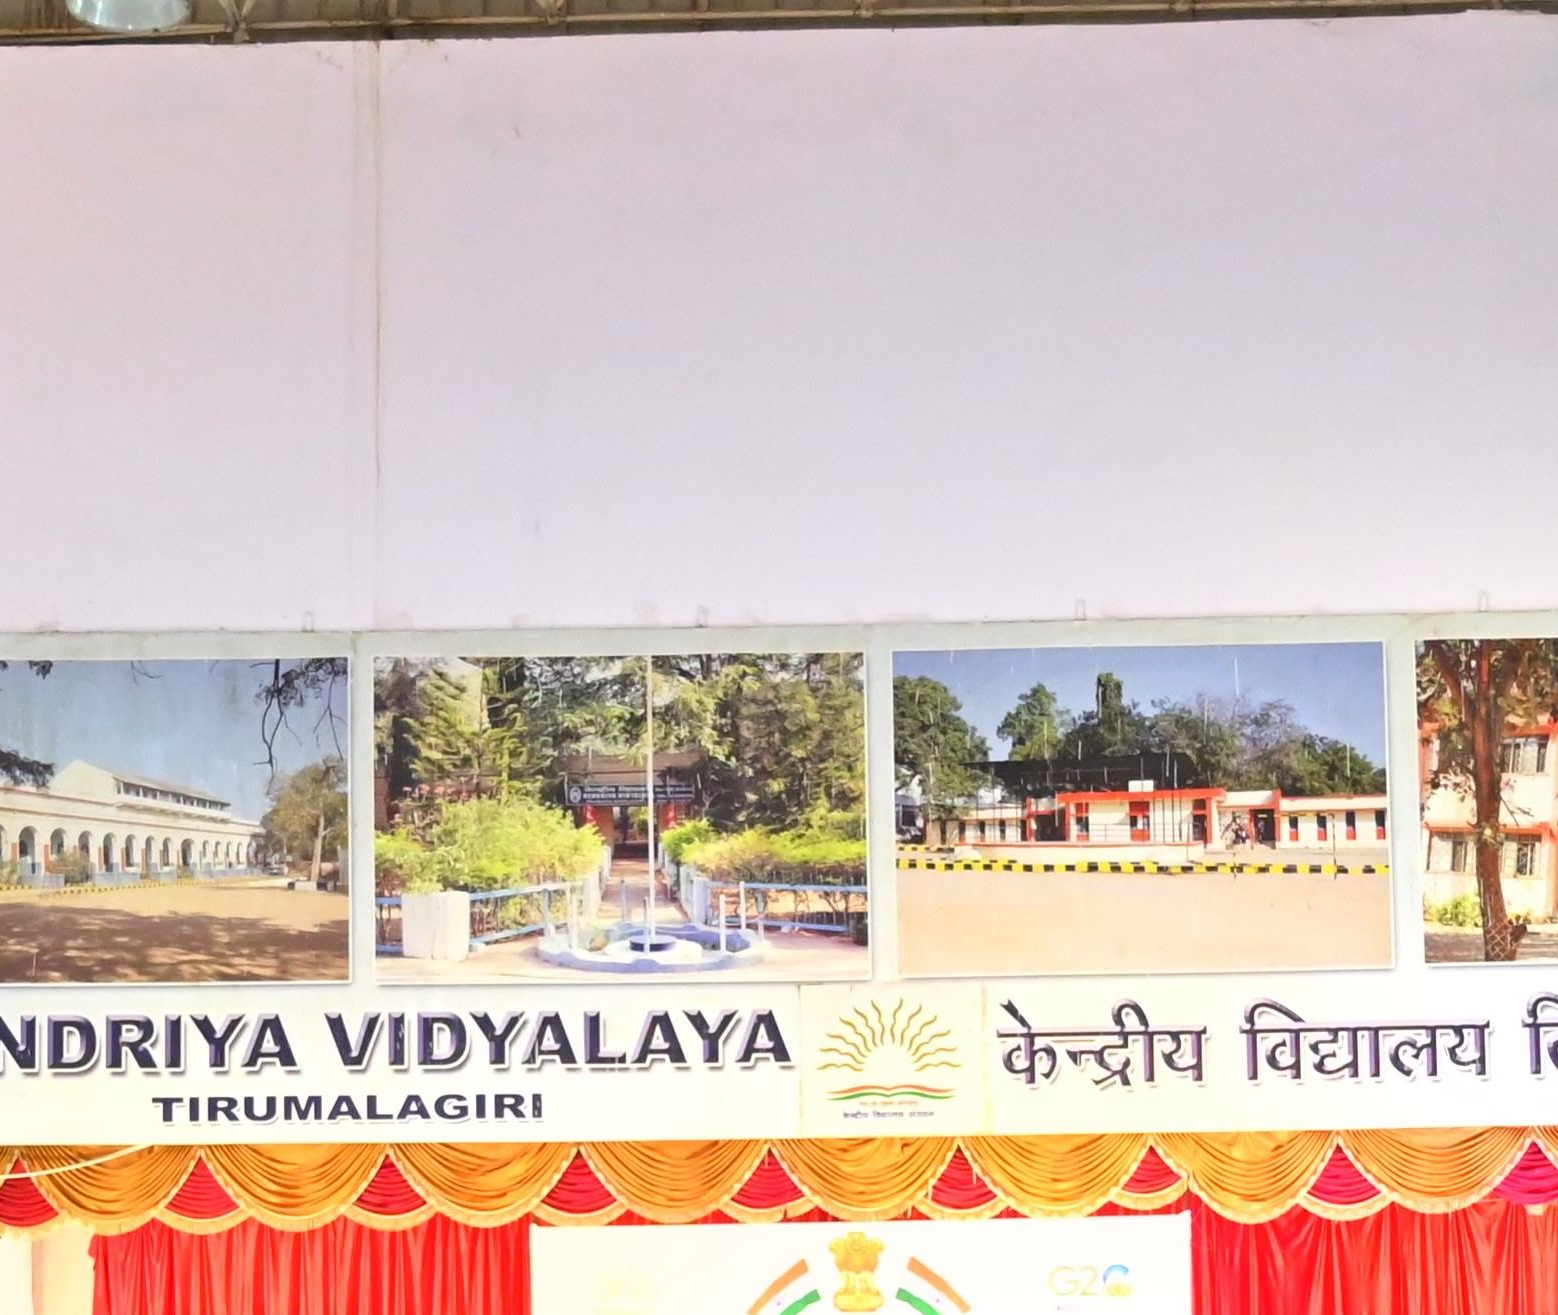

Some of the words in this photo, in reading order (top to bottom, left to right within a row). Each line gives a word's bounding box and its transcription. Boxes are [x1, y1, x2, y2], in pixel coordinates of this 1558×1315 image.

[325, 1007, 795, 1070] VIDYALAYA
[997, 999, 1207, 1087] केन्द्रीय
[1241, 999, 1491, 1083] विद्यालय
[152, 1093, 545, 1123] TIRUMALAGIRI
